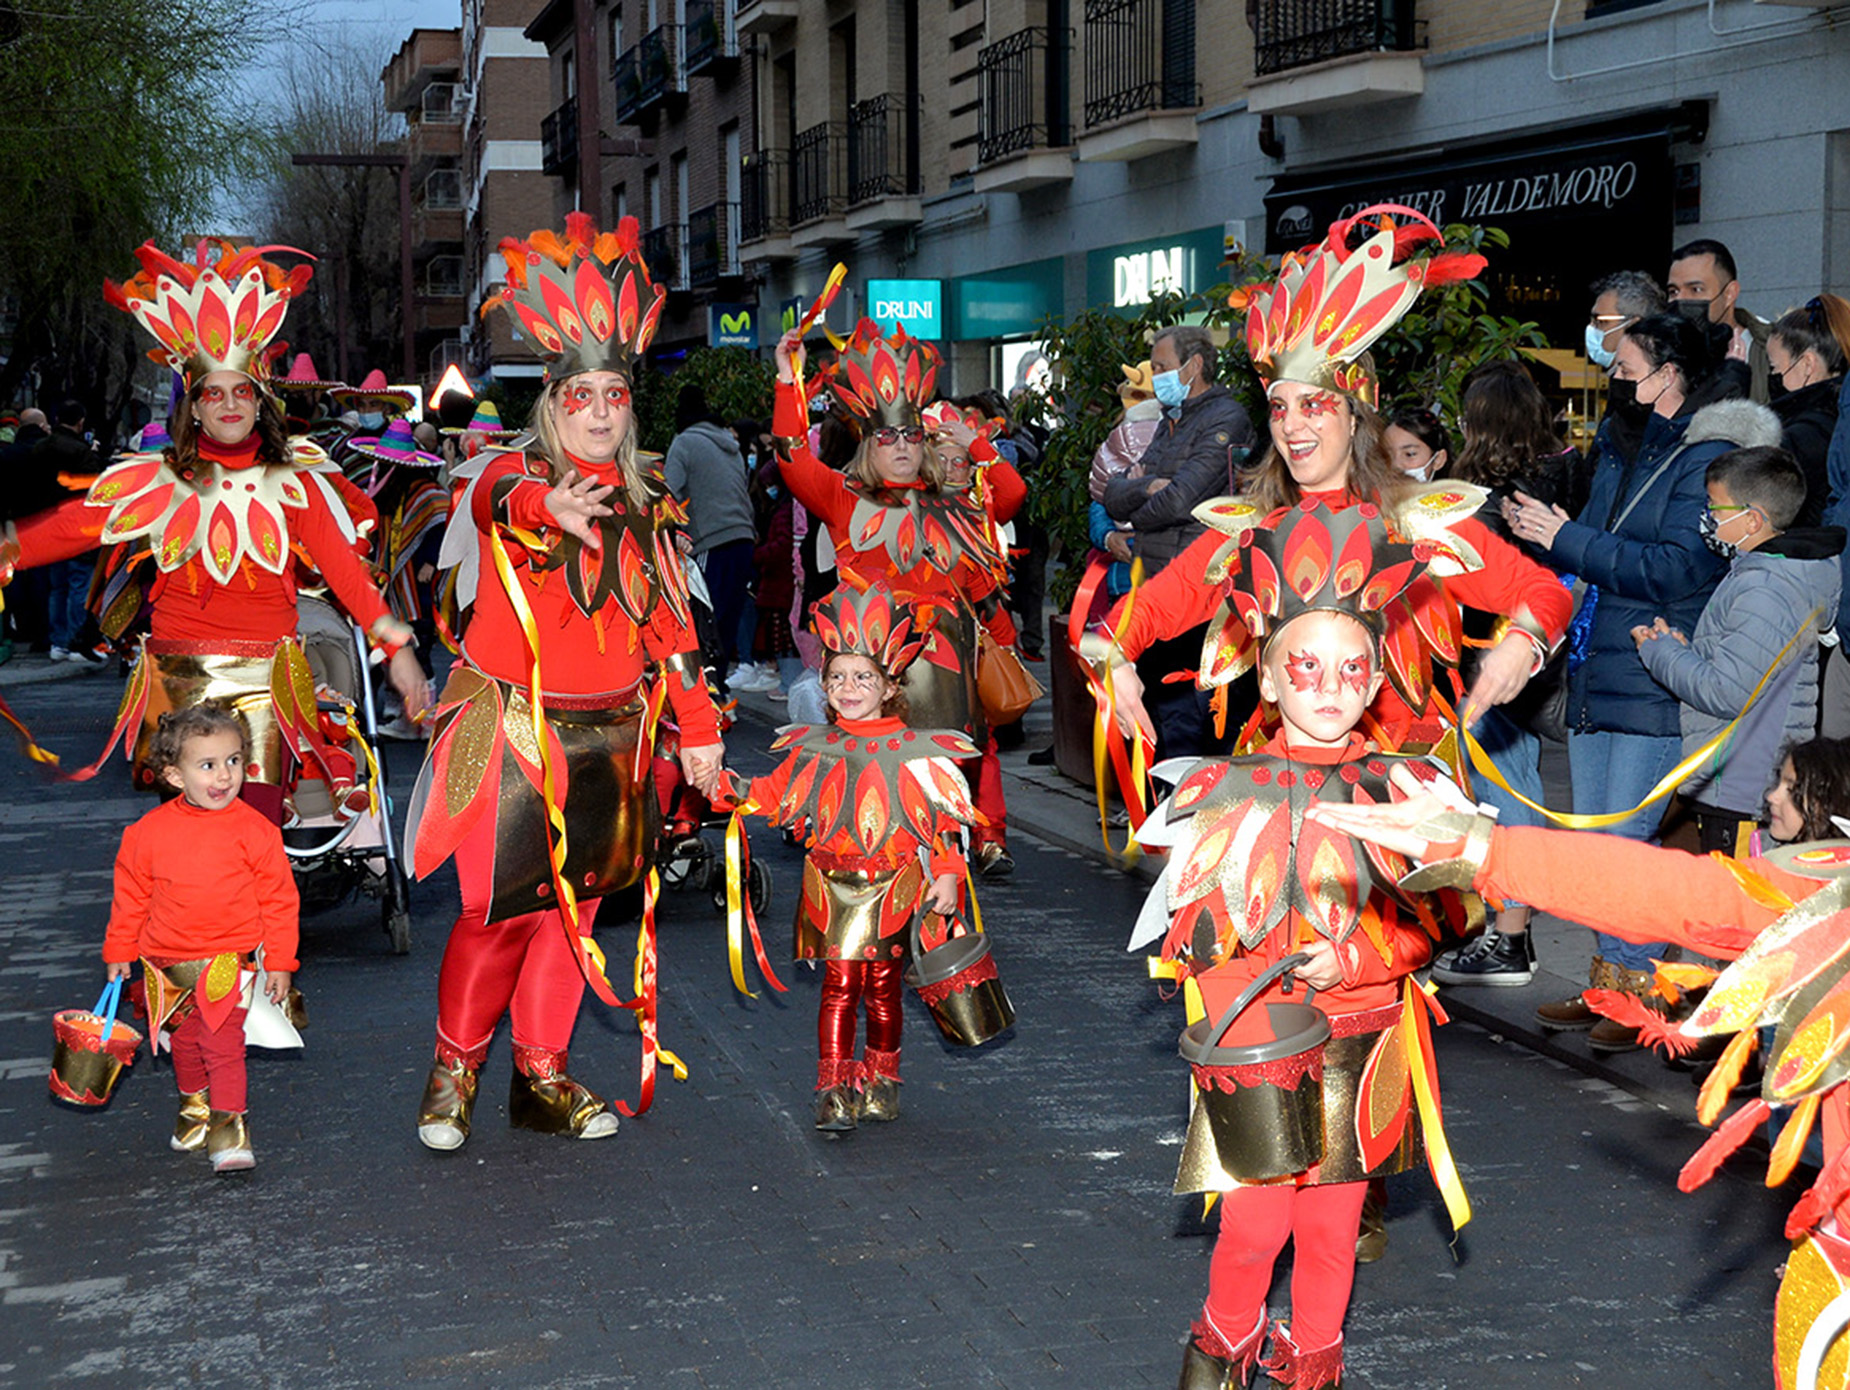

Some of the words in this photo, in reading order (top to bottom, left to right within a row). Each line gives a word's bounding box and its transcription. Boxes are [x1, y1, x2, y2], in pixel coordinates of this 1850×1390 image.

[1460, 161, 1637, 218] VALDEMORO
[1114, 246, 1183, 307] DRUNI
[876, 301, 932, 318] DRUNI
